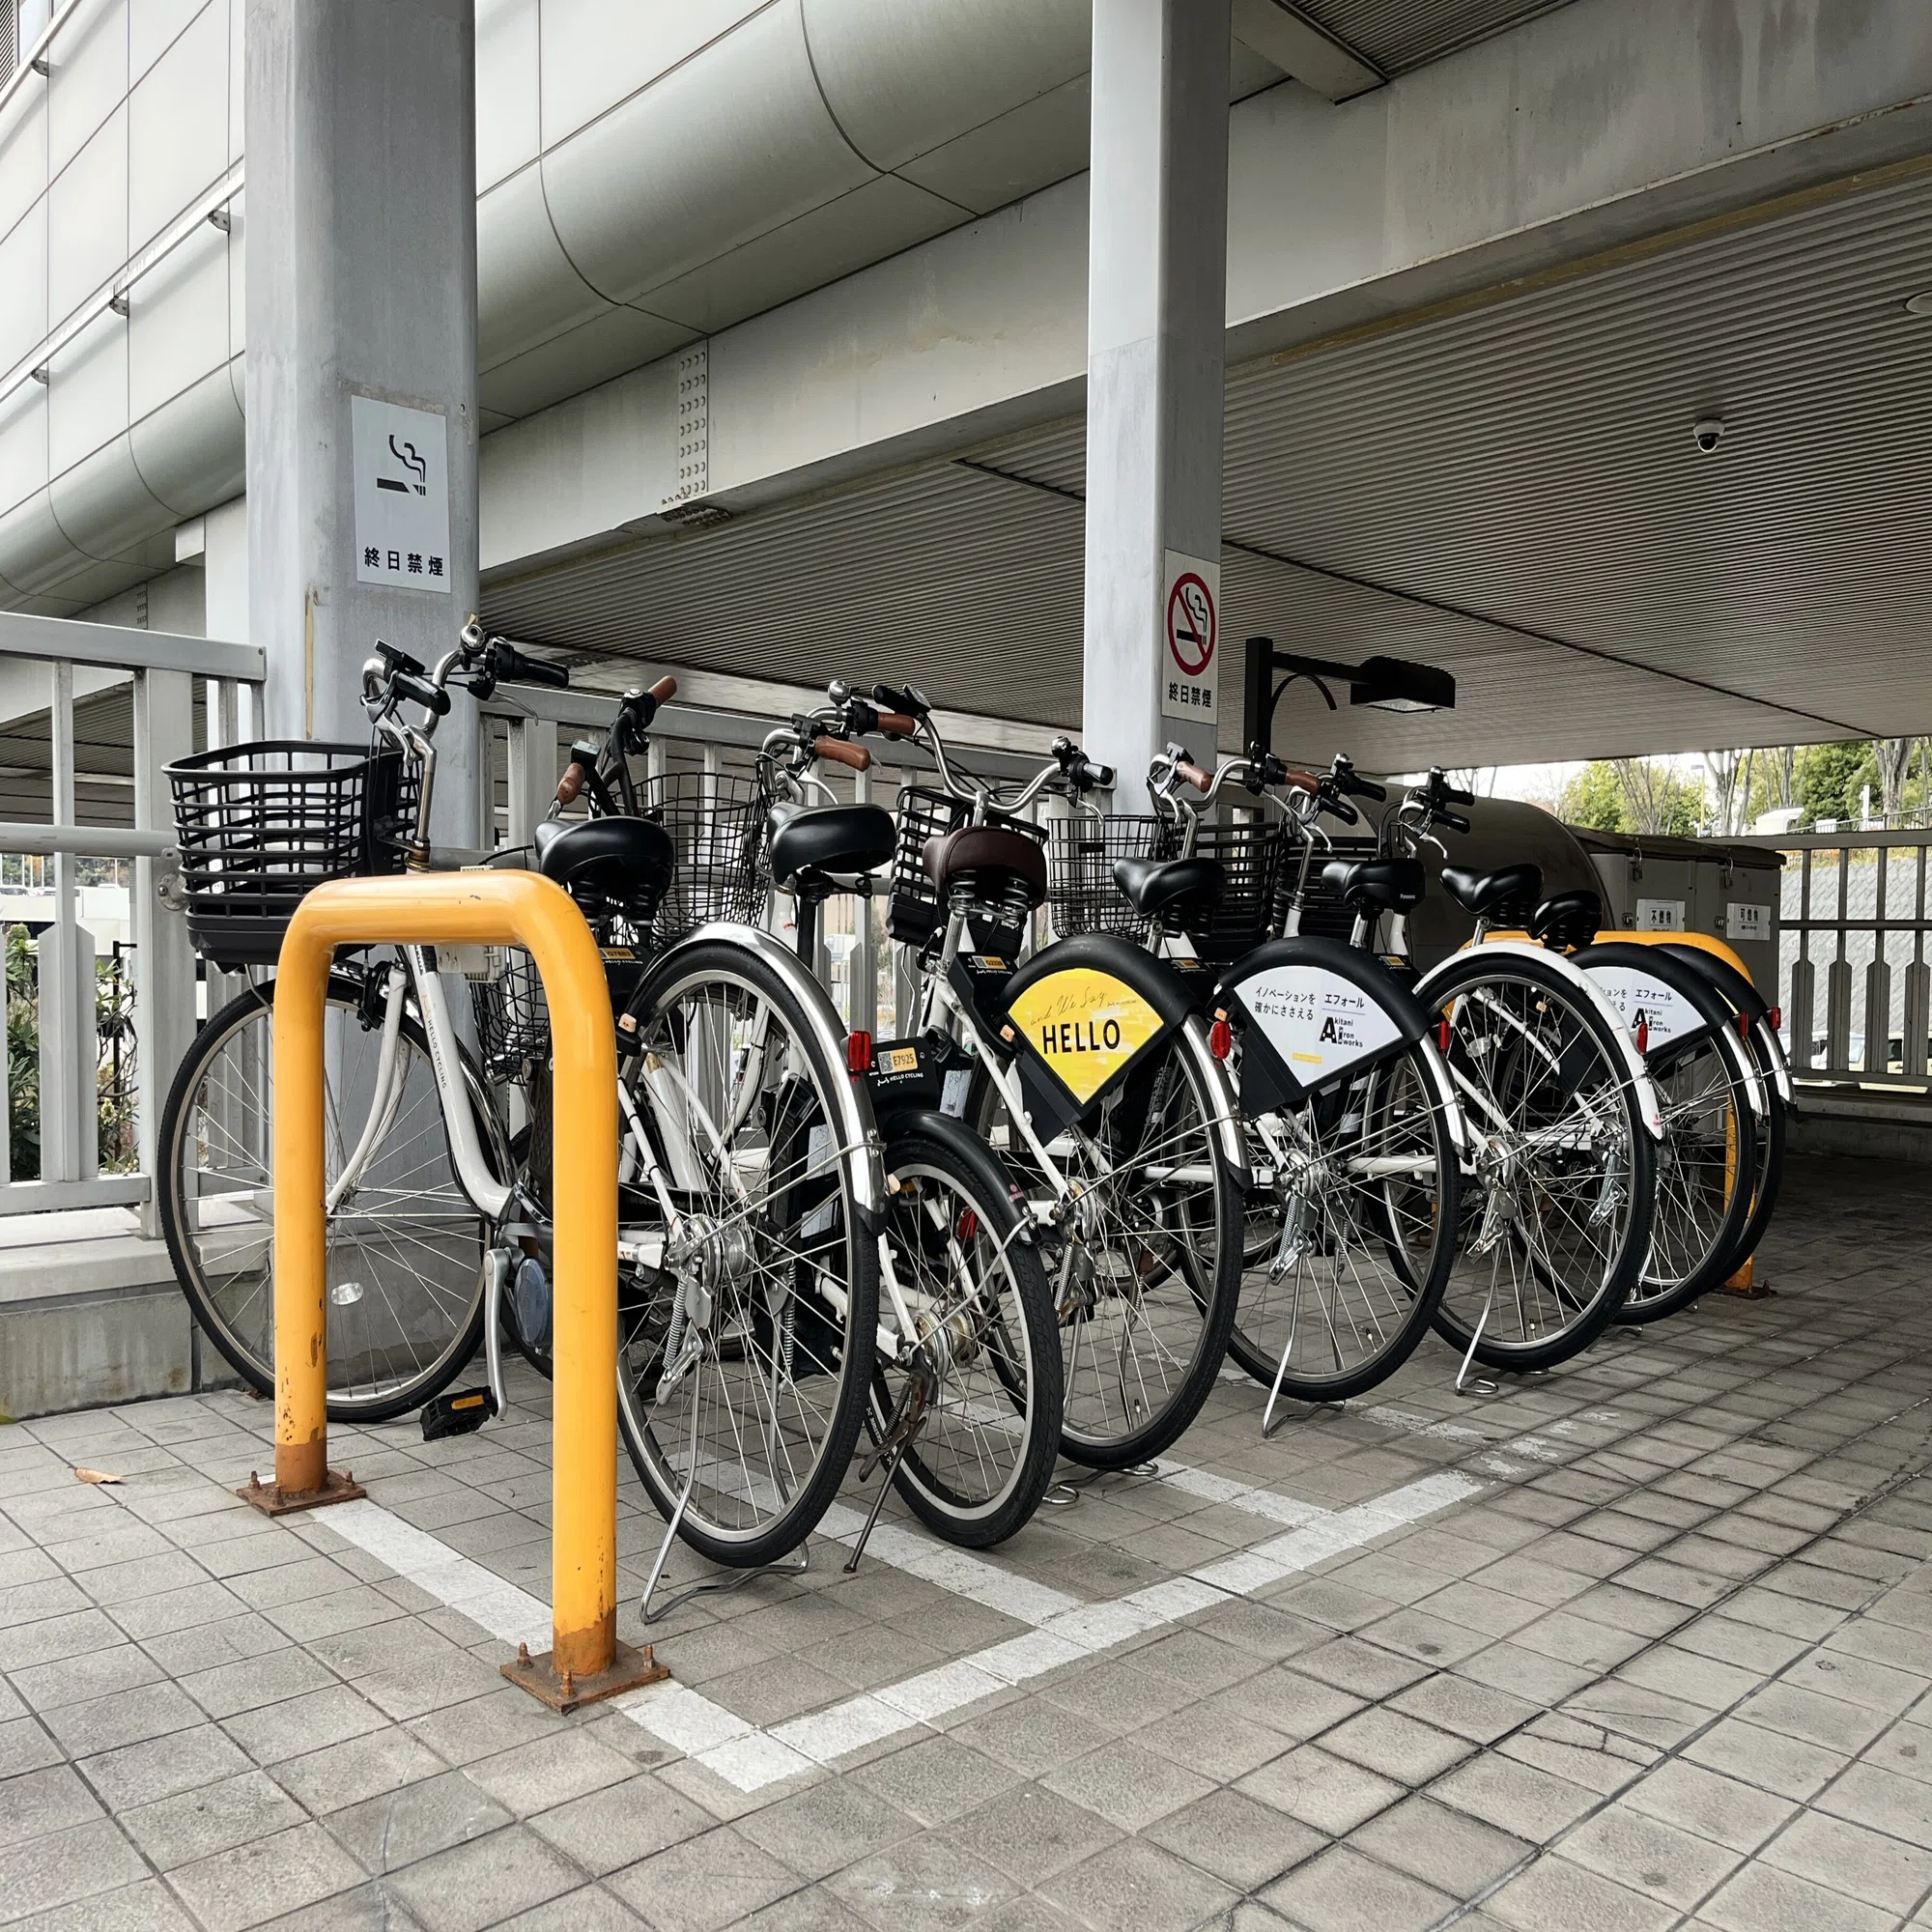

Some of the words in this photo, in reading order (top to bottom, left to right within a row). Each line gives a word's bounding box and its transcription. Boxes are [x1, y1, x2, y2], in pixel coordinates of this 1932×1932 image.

[364, 547, 443, 577] 終日禁煙
[1169, 682, 1211, 708] 終日禁煙
[1255, 986, 1316, 1005] イノベーションを
[1324, 993, 1365, 1009] エフォール
[1635, 988, 1672, 1001] エフォール
[1030, 1006, 1053, 1026] and
[1057, 994, 1076, 1016] We
[1080, 986, 1106, 1009] Say
[1254, 1001, 1314, 1021] 確かにささえる
[1042, 1018, 1121, 1054] HELLO
[1653, 1025, 1672, 1034] works
[1343, 1039, 1364, 1048] works
[428, 1019, 439, 1049] HELLO
[435, 1051, 447, 1089] CYCLING
[893, 1054, 915, 1066] E7925
[889, 1073, 905, 1082] HELLO
